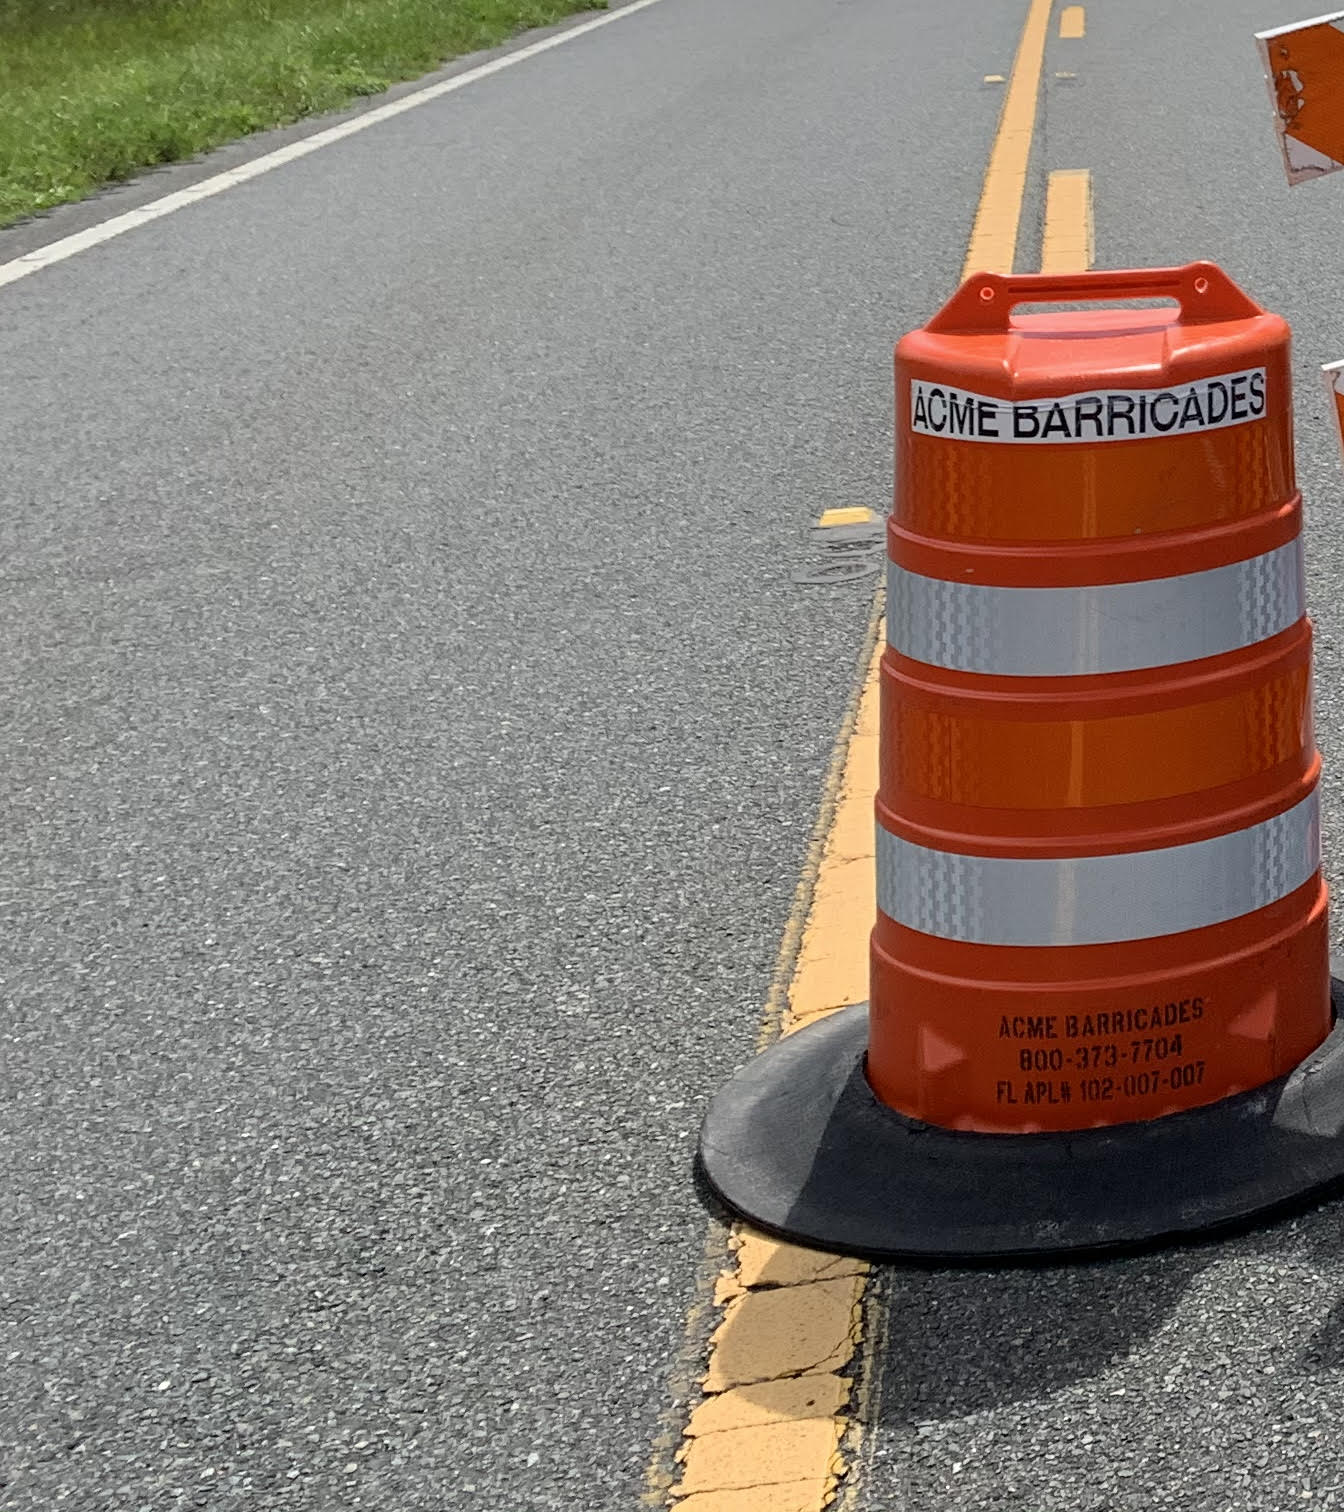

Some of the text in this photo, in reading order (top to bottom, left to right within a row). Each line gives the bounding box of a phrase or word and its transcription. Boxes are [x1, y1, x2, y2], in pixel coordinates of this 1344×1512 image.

[913, 372, 1265, 439] ACME BARRICADES
[999, 997, 1204, 1040] ACME BARRICADES
[1019, 1034, 1183, 1072] 800-373-7704
[996, 1061, 1206, 1105] FL APL# 102-007-007
